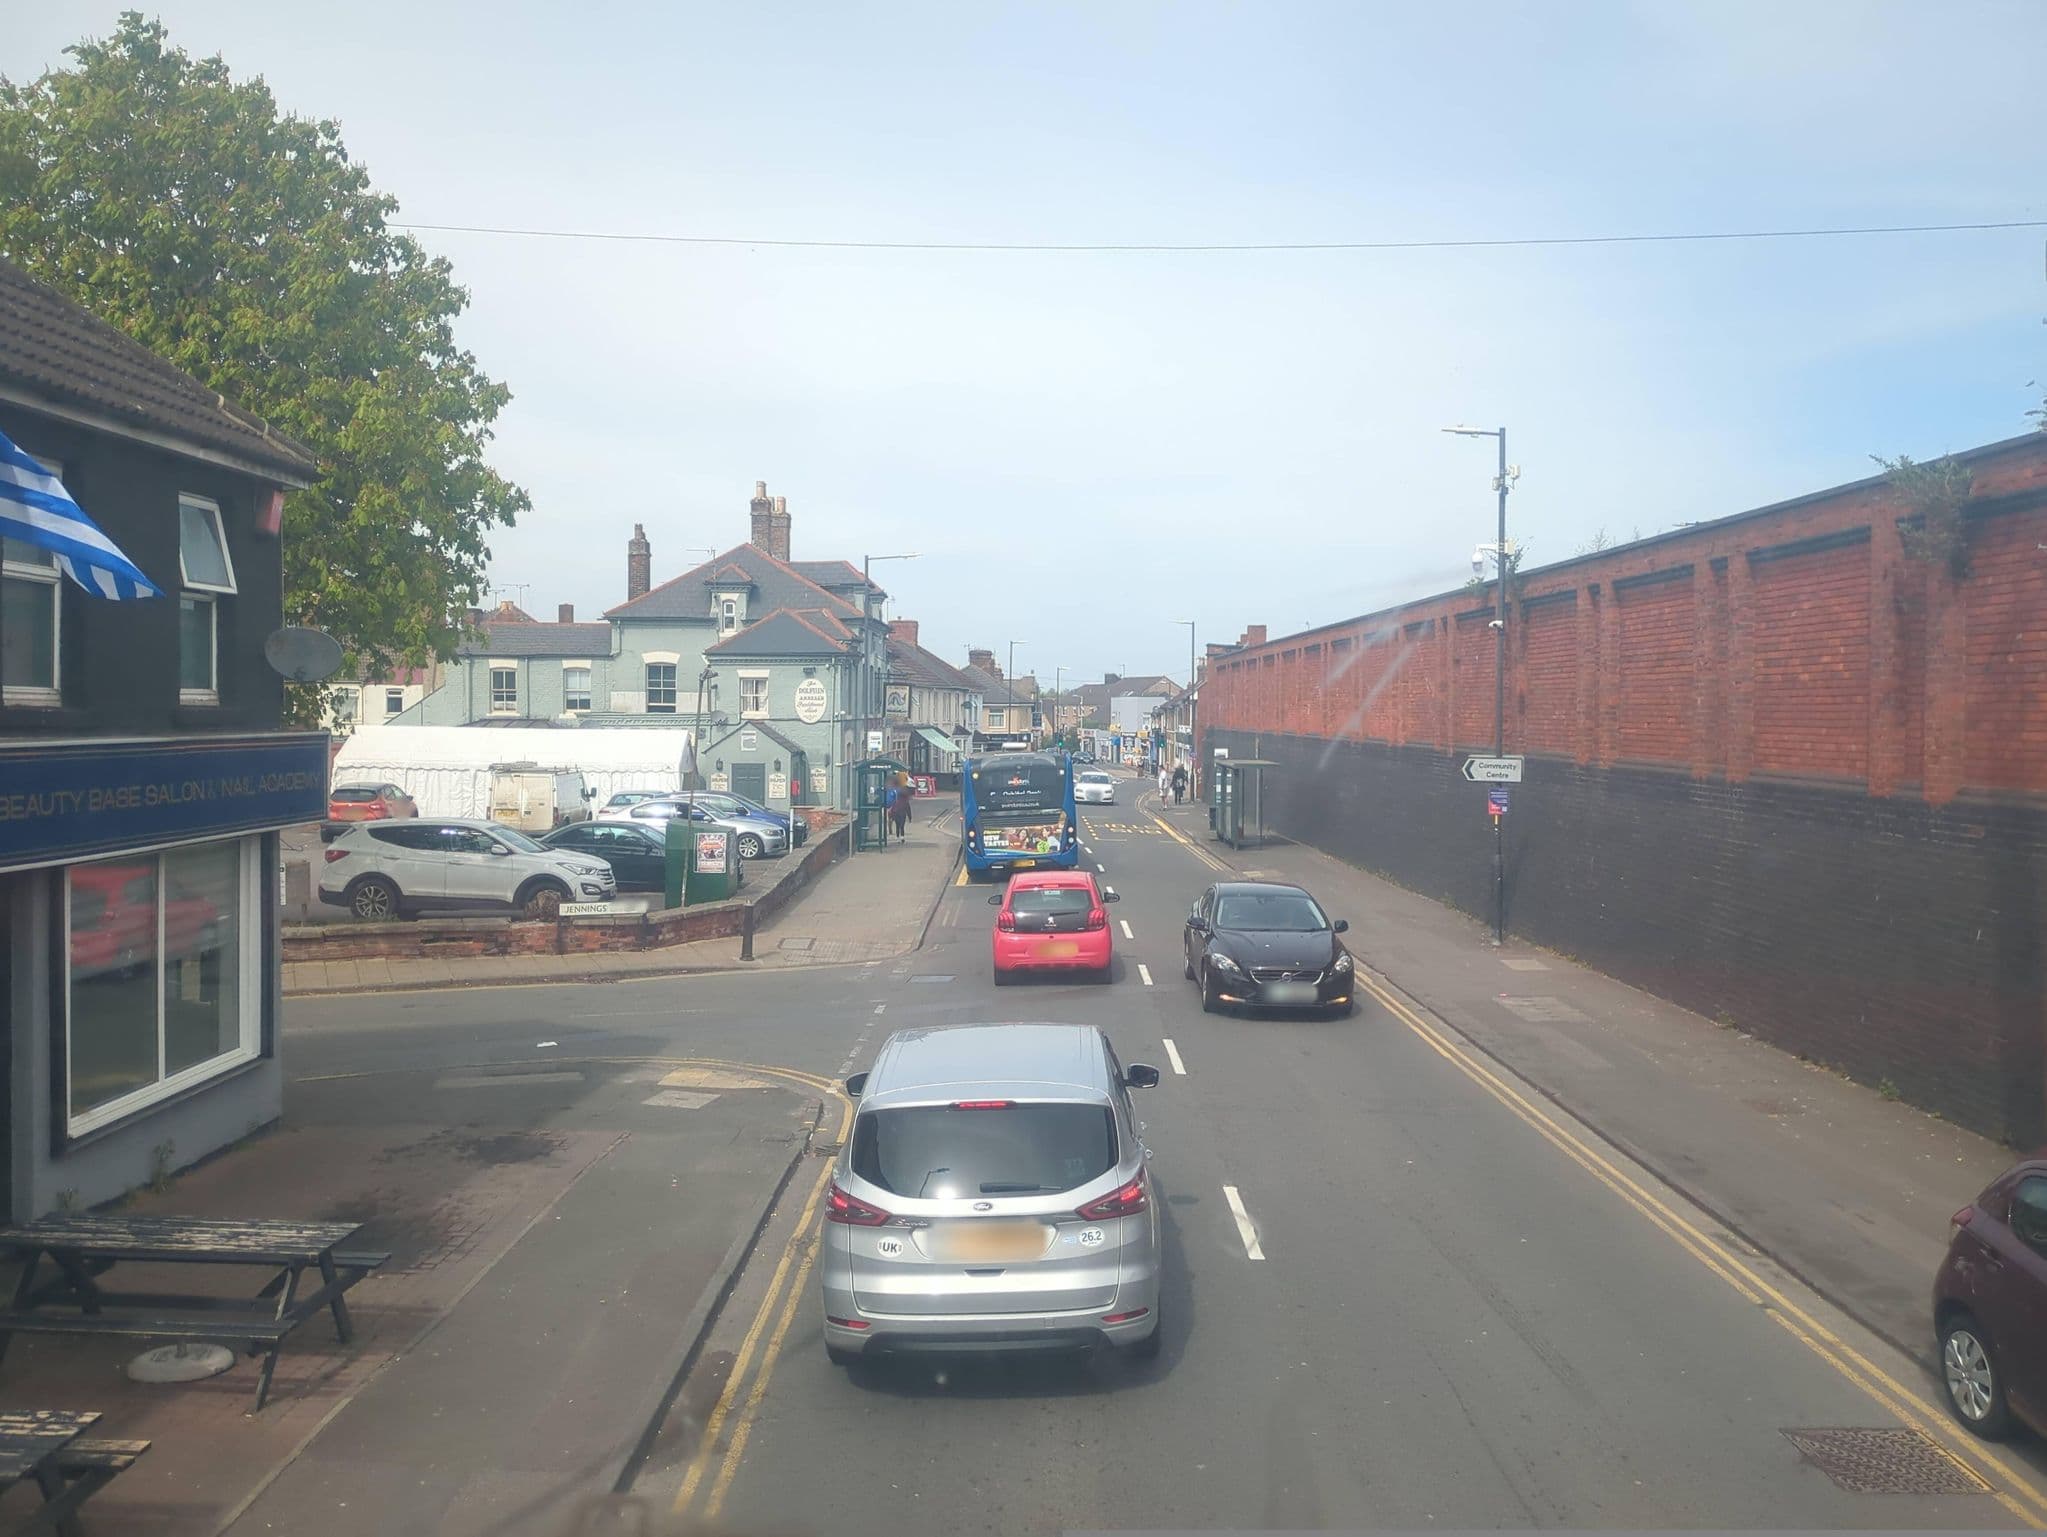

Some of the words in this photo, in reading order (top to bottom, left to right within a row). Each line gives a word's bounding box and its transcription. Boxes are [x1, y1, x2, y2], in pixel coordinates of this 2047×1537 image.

[1479, 763, 1516, 771] Community
[0, 790, 83, 821] BEAUTY
[88, 786, 141, 811] BASE
[144, 778, 205, 805] SALON
[221, 776, 255, 797] NAIL
[565, 905, 608, 913] JENNINGS
[1081, 1230, 1102, 1242] 26.2
[882, 1241, 898, 1254] UK
